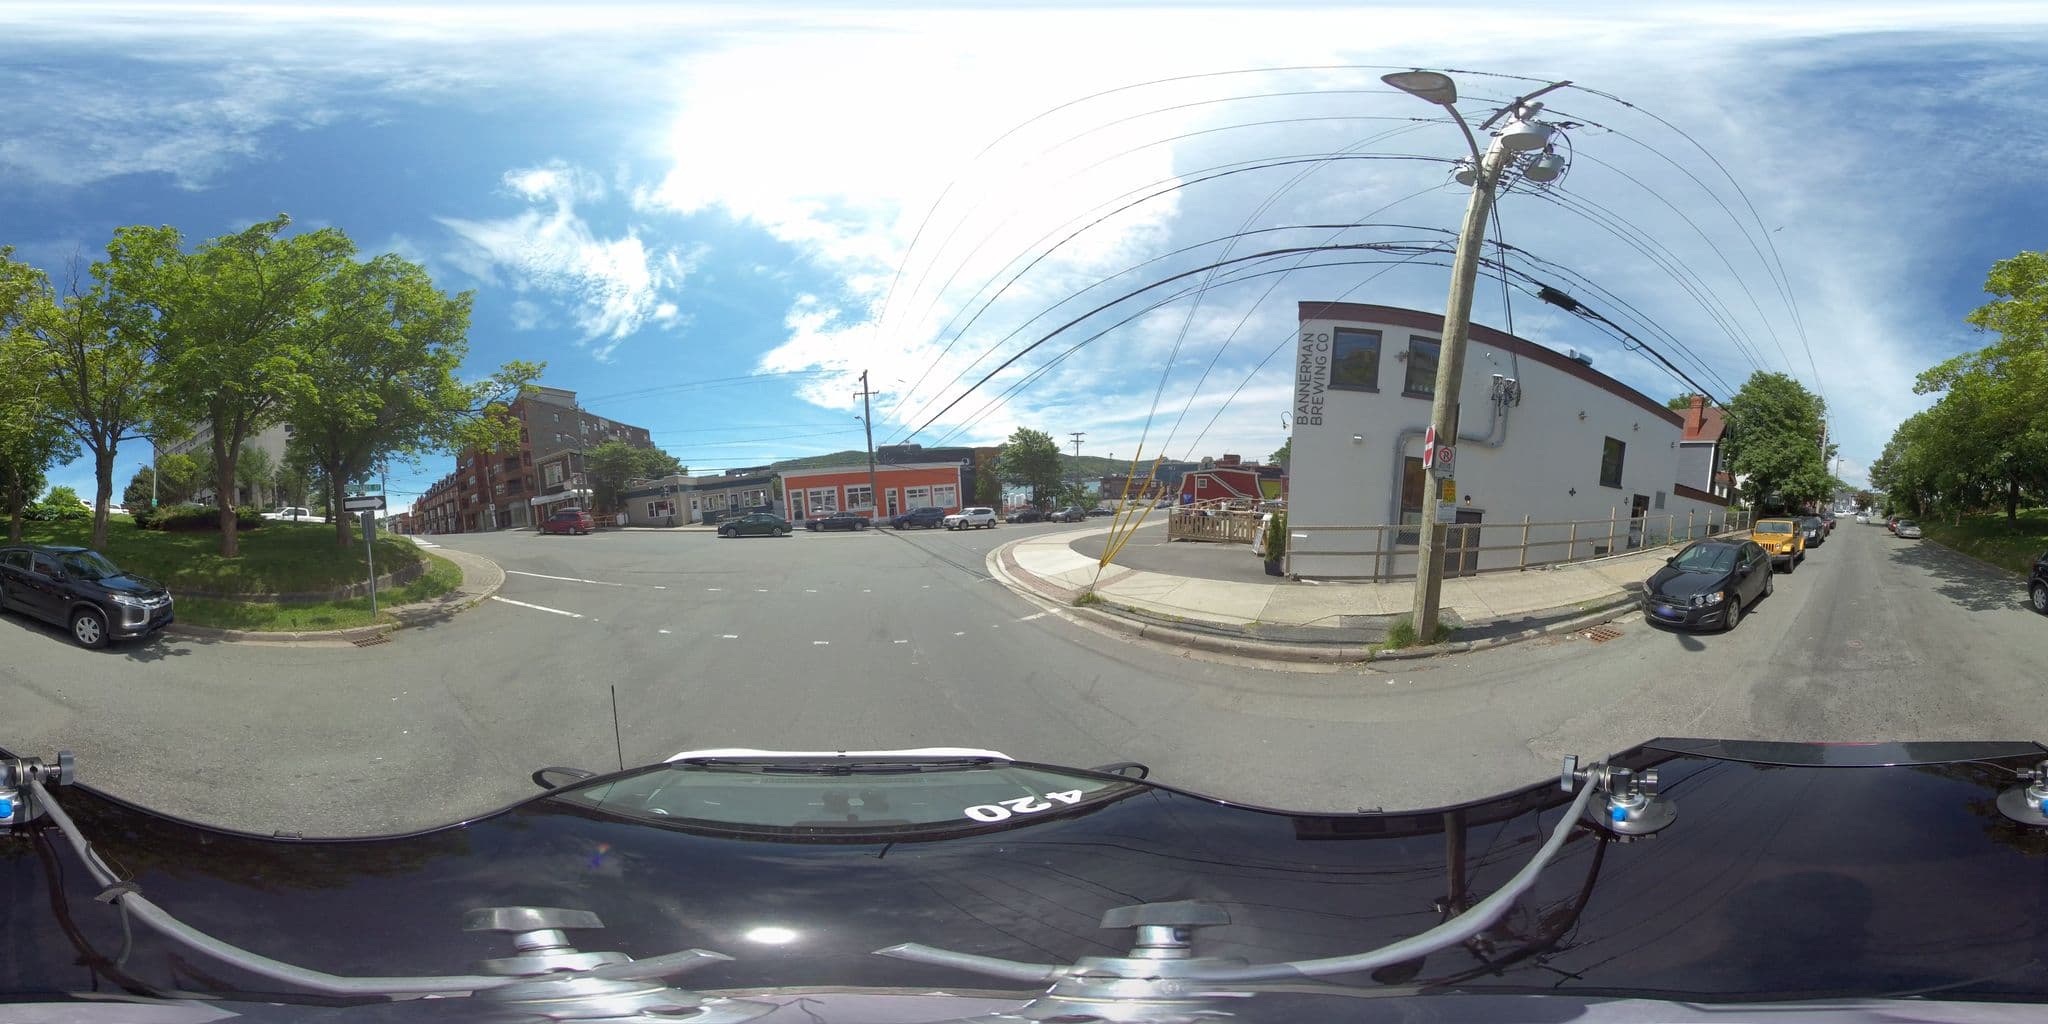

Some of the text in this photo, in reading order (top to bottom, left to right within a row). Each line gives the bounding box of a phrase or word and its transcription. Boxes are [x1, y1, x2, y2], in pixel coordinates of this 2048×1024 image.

[1297, 333, 1314, 425] BANNERMAN
[1311, 333, 1329, 426] BREWING CO
[964, 789, 1083, 822] 420
